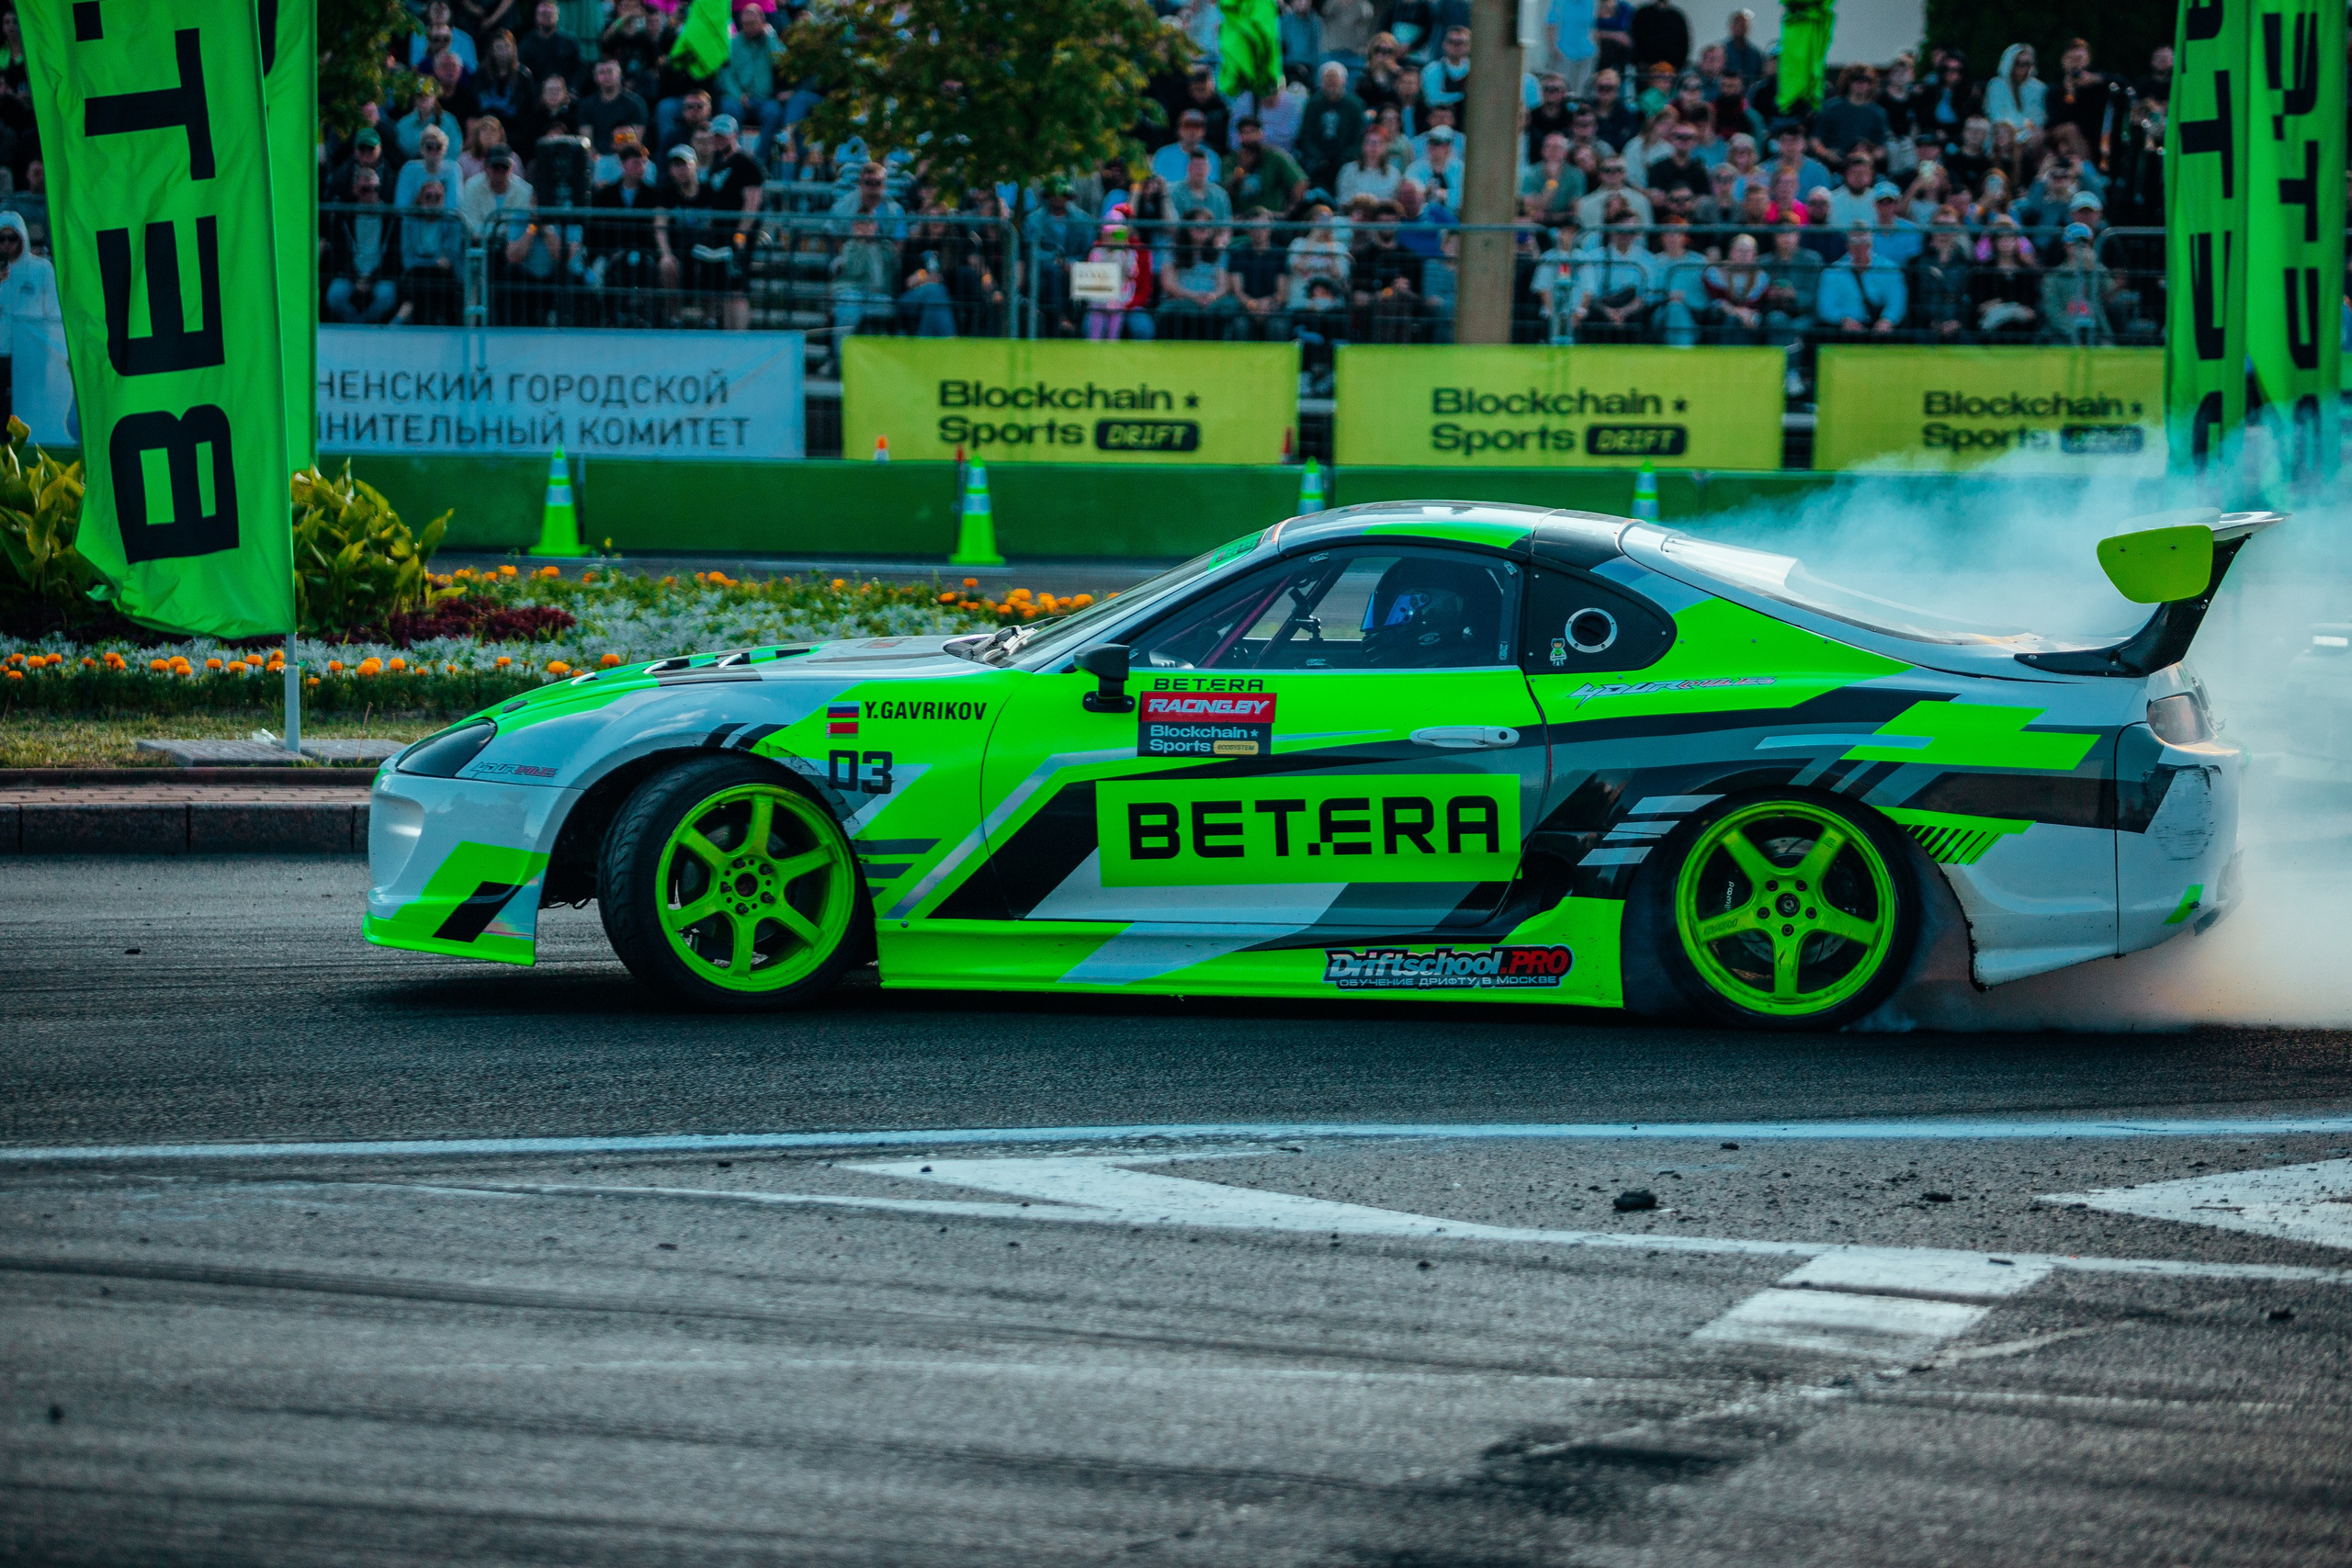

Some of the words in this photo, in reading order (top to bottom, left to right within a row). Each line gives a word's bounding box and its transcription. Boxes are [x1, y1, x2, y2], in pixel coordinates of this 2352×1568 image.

[508, 368, 729, 408] ГОРОДСКОЙ
[939, 378, 1173, 411] Blockchain
[1431, 387, 1662, 416] Blockchain
[1924, 390, 2124, 416] Blockchain
[317, 411, 564, 446] НИТЕЛЬНЫЙ
[579, 416, 750, 447] КОМИТЕТ
[938, 415, 1085, 449] Sports
[1105, 423, 1189, 445] DRIFT
[1430, 422, 1576, 457] Sports
[1922, 423, 2051, 451] Sports
[1154, 678, 1263, 692] BET.ERA
[865, 701, 988, 720] Y.GAVRIKOV
[1148, 698, 1270, 715] RACING.BY
[1149, 739, 1212, 753] Sports
[1216, 743, 1255, 751] ECOSYSTEM
[1150, 725, 1248, 739] Blockchain
[829, 750, 893, 795] 03
[1127, 795, 1500, 860] BET.ERA
[1339, 978, 1414, 987] ОБУЧЕНИЕ
[1419, 976, 1480, 987] ДРИФТУ
[1496, 976, 1557, 986] МОСКВЕ
